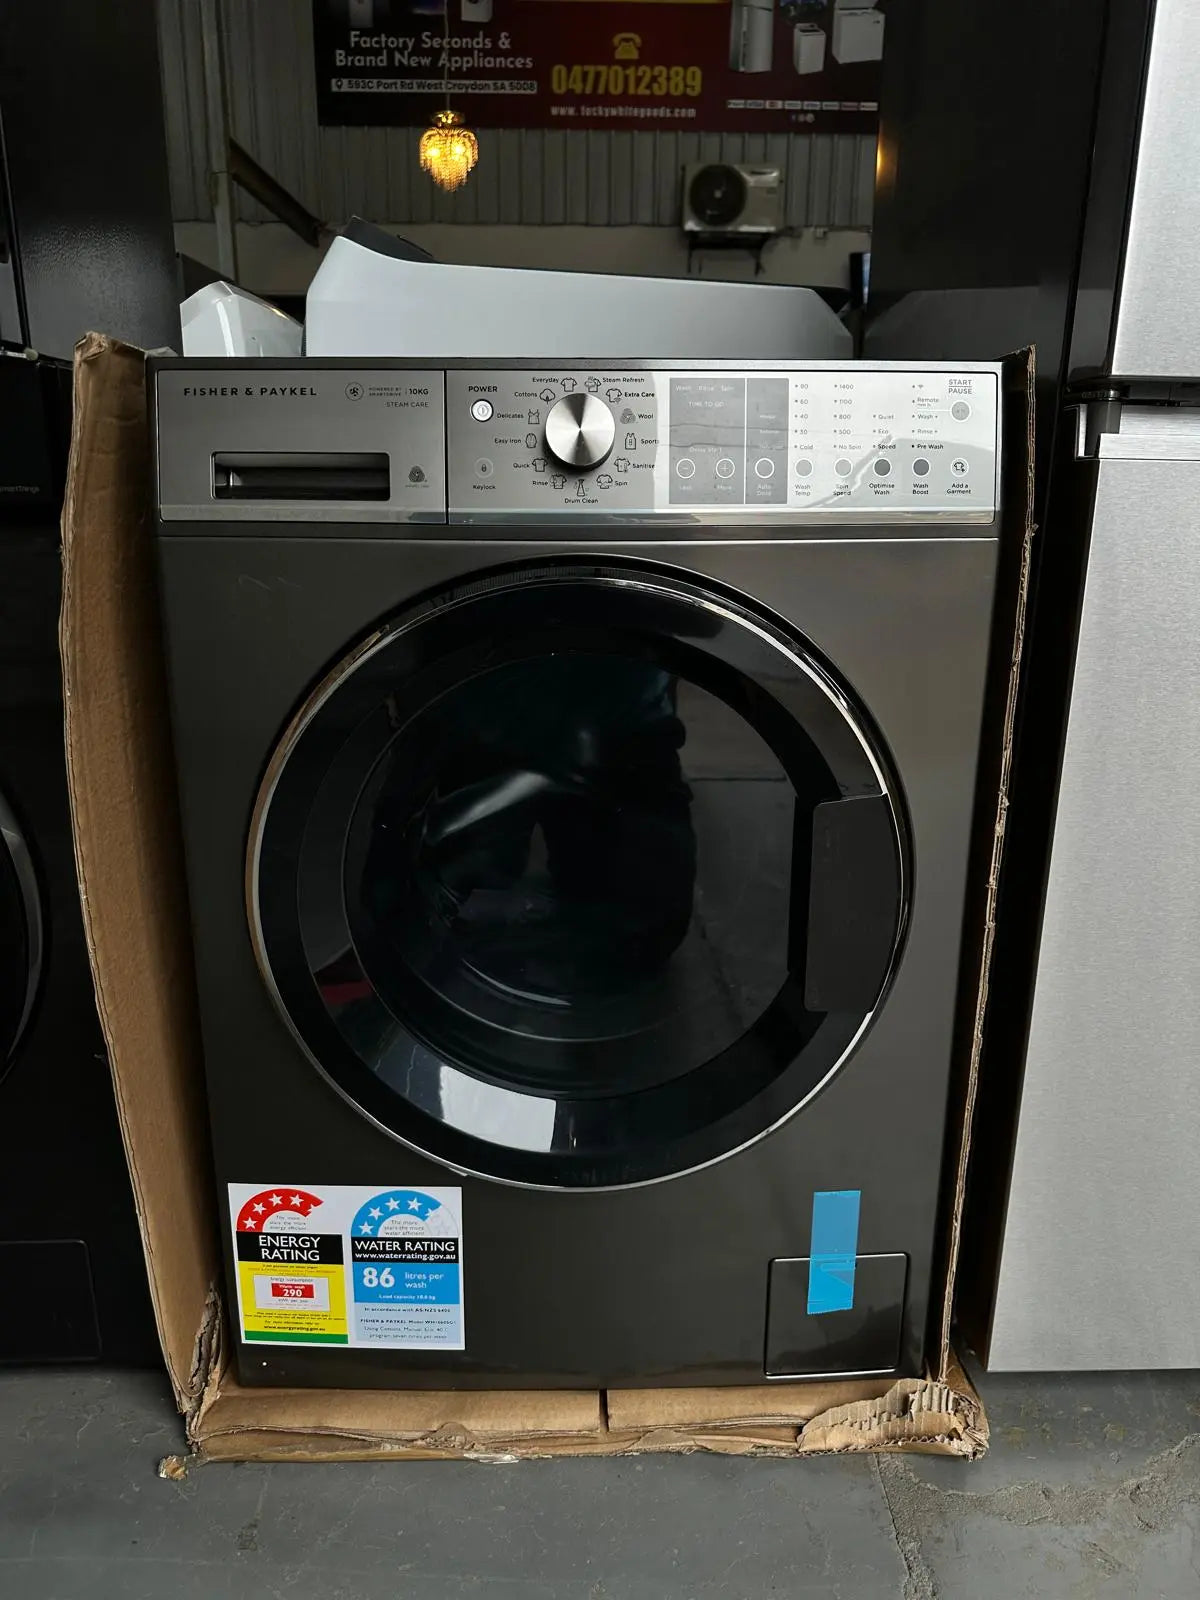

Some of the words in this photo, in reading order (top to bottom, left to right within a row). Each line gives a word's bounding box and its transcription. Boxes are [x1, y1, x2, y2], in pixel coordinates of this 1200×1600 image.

[350, 31, 415, 50] Factory
[421, 30, 492, 49] Seconds
[498, 32, 512, 49] &
[335, 50, 388, 67] Brand
[394, 51, 431, 67] New
[438, 52, 533, 72] Appliances
[551, 64, 703, 96] 0477012389
[376, 80, 398, 89] Port
[400, 80, 414, 89] Rd
[416, 80, 443, 90] West
[446, 81, 491, 93] Croydon
[492, 82, 506, 91] SA
[509, 82, 536, 92] 5008
[183, 387, 239, 396] FISHER
[244, 387, 254, 396] &
[260, 387, 317, 396] PAYKEL
[614, 480, 628, 488] Spin
[259, 1235, 320, 1248] ENERGY
[354, 1240, 401, 1251] WATER
[404, 1241, 455, 1252] RATING
[261, 1248, 320, 1262] RATING
[354, 1252, 456, 1261] www.waterrating.gov.au
[362, 1266, 395, 1288] 86
[404, 1272, 426, 1280] litres
[429, 1273, 444, 1284] per
[405, 1281, 427, 1289] wash
[282, 1288, 302, 1297] 290
